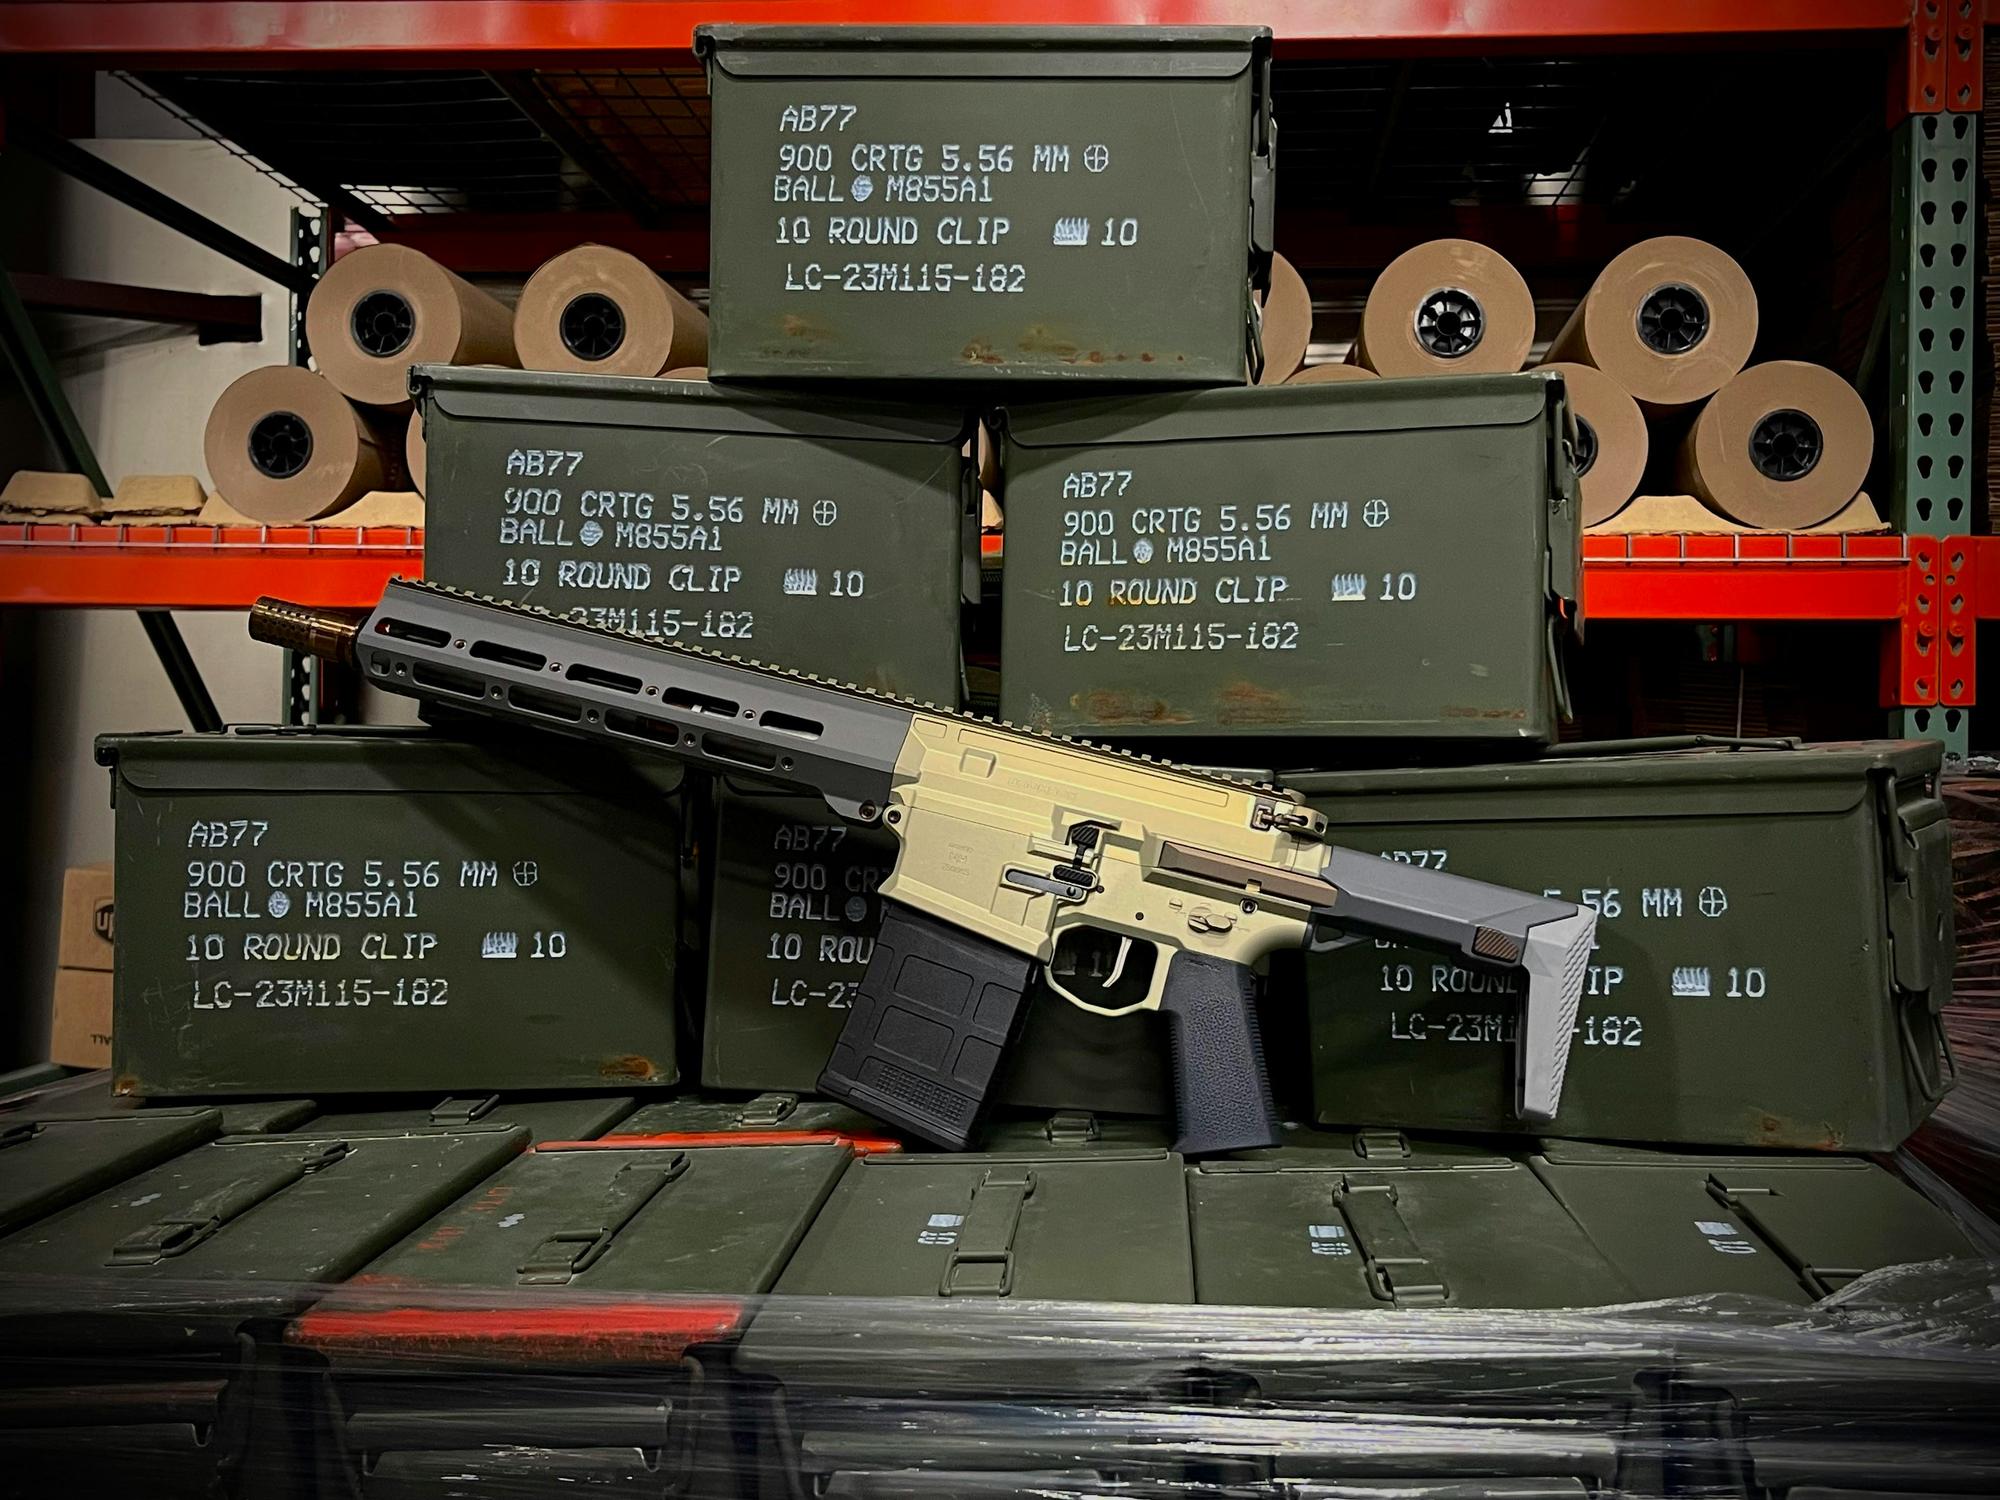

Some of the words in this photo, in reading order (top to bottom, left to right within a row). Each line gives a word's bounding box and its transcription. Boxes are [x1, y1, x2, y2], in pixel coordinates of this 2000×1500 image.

[780, 105, 856, 131] AB77
[780, 145, 831, 171] 900
[852, 144, 923, 171] CRTG
[942, 145, 1013, 172] 5.56
[1033, 145, 1069, 172] MM
[774, 175, 843, 201] BALL
[886, 175, 992, 201] M855A1
[776, 217, 810, 243] 10
[829, 217, 917, 244] ROUND
[937, 218, 1009, 244] CLIP
[1101, 218, 1137, 245] 10
[785, 264, 1025, 292] LC-23M115-182
[507, 450, 583, 476] AB77
[1063, 471, 1132, 498] AB77
[505, 488, 561, 515] 900
[581, 491, 654, 518] CRTG
[672, 495, 743, 522] 5.56
[762, 498, 798, 524] MM
[1065, 511, 1113, 536] 900
[1133, 507, 1201, 533] CRTG
[1220, 504, 1290, 531] 5.56
[1311, 502, 1347, 528] MM
[500, 518, 573, 545] BALL
[615, 522, 721, 550] M855A1
[1061, 539, 1127, 565] BALL
[1167, 535, 1271, 562] M855A1
[503, 559, 540, 586] 10
[559, 561, 650, 589] ROUND
[669, 565, 741, 592] CLIP
[830, 571, 863, 596] 10
[1060, 581, 1092, 606] 10
[1111, 579, 1197, 604] ROUND
[1216, 576, 1288, 603] CLIP
[1380, 574, 1415, 600] 10
[570, 608, 753, 638] 3M115-182
[1065, 622, 1298, 651] LC-23M115-182
[188, 820, 267, 847] AB77
[775, 825, 847, 851] AB77
[188, 861, 245, 887] 900
[268, 861, 343, 887] CRTG
[364, 861, 439, 887] 5.56
[460, 861, 497, 886] MM
[775, 864, 825, 890] 900
[184, 891, 260, 918] BALL
[306, 892, 417, 917] M855A1
[770, 893, 839, 920] BALL
[1643, 889, 1682, 917] MM
[186, 935, 223, 960] 10
[244, 934, 340, 960] ROUND
[361, 933, 437, 959] CLIP
[531, 932, 565, 957] 10
[767, 933, 801, 959] 10
[819, 936, 873, 964] ROU
[194, 978, 448, 1009] LC-23M115-182
[1381, 966, 1412, 991] 10
[1727, 968, 1765, 997] 10
